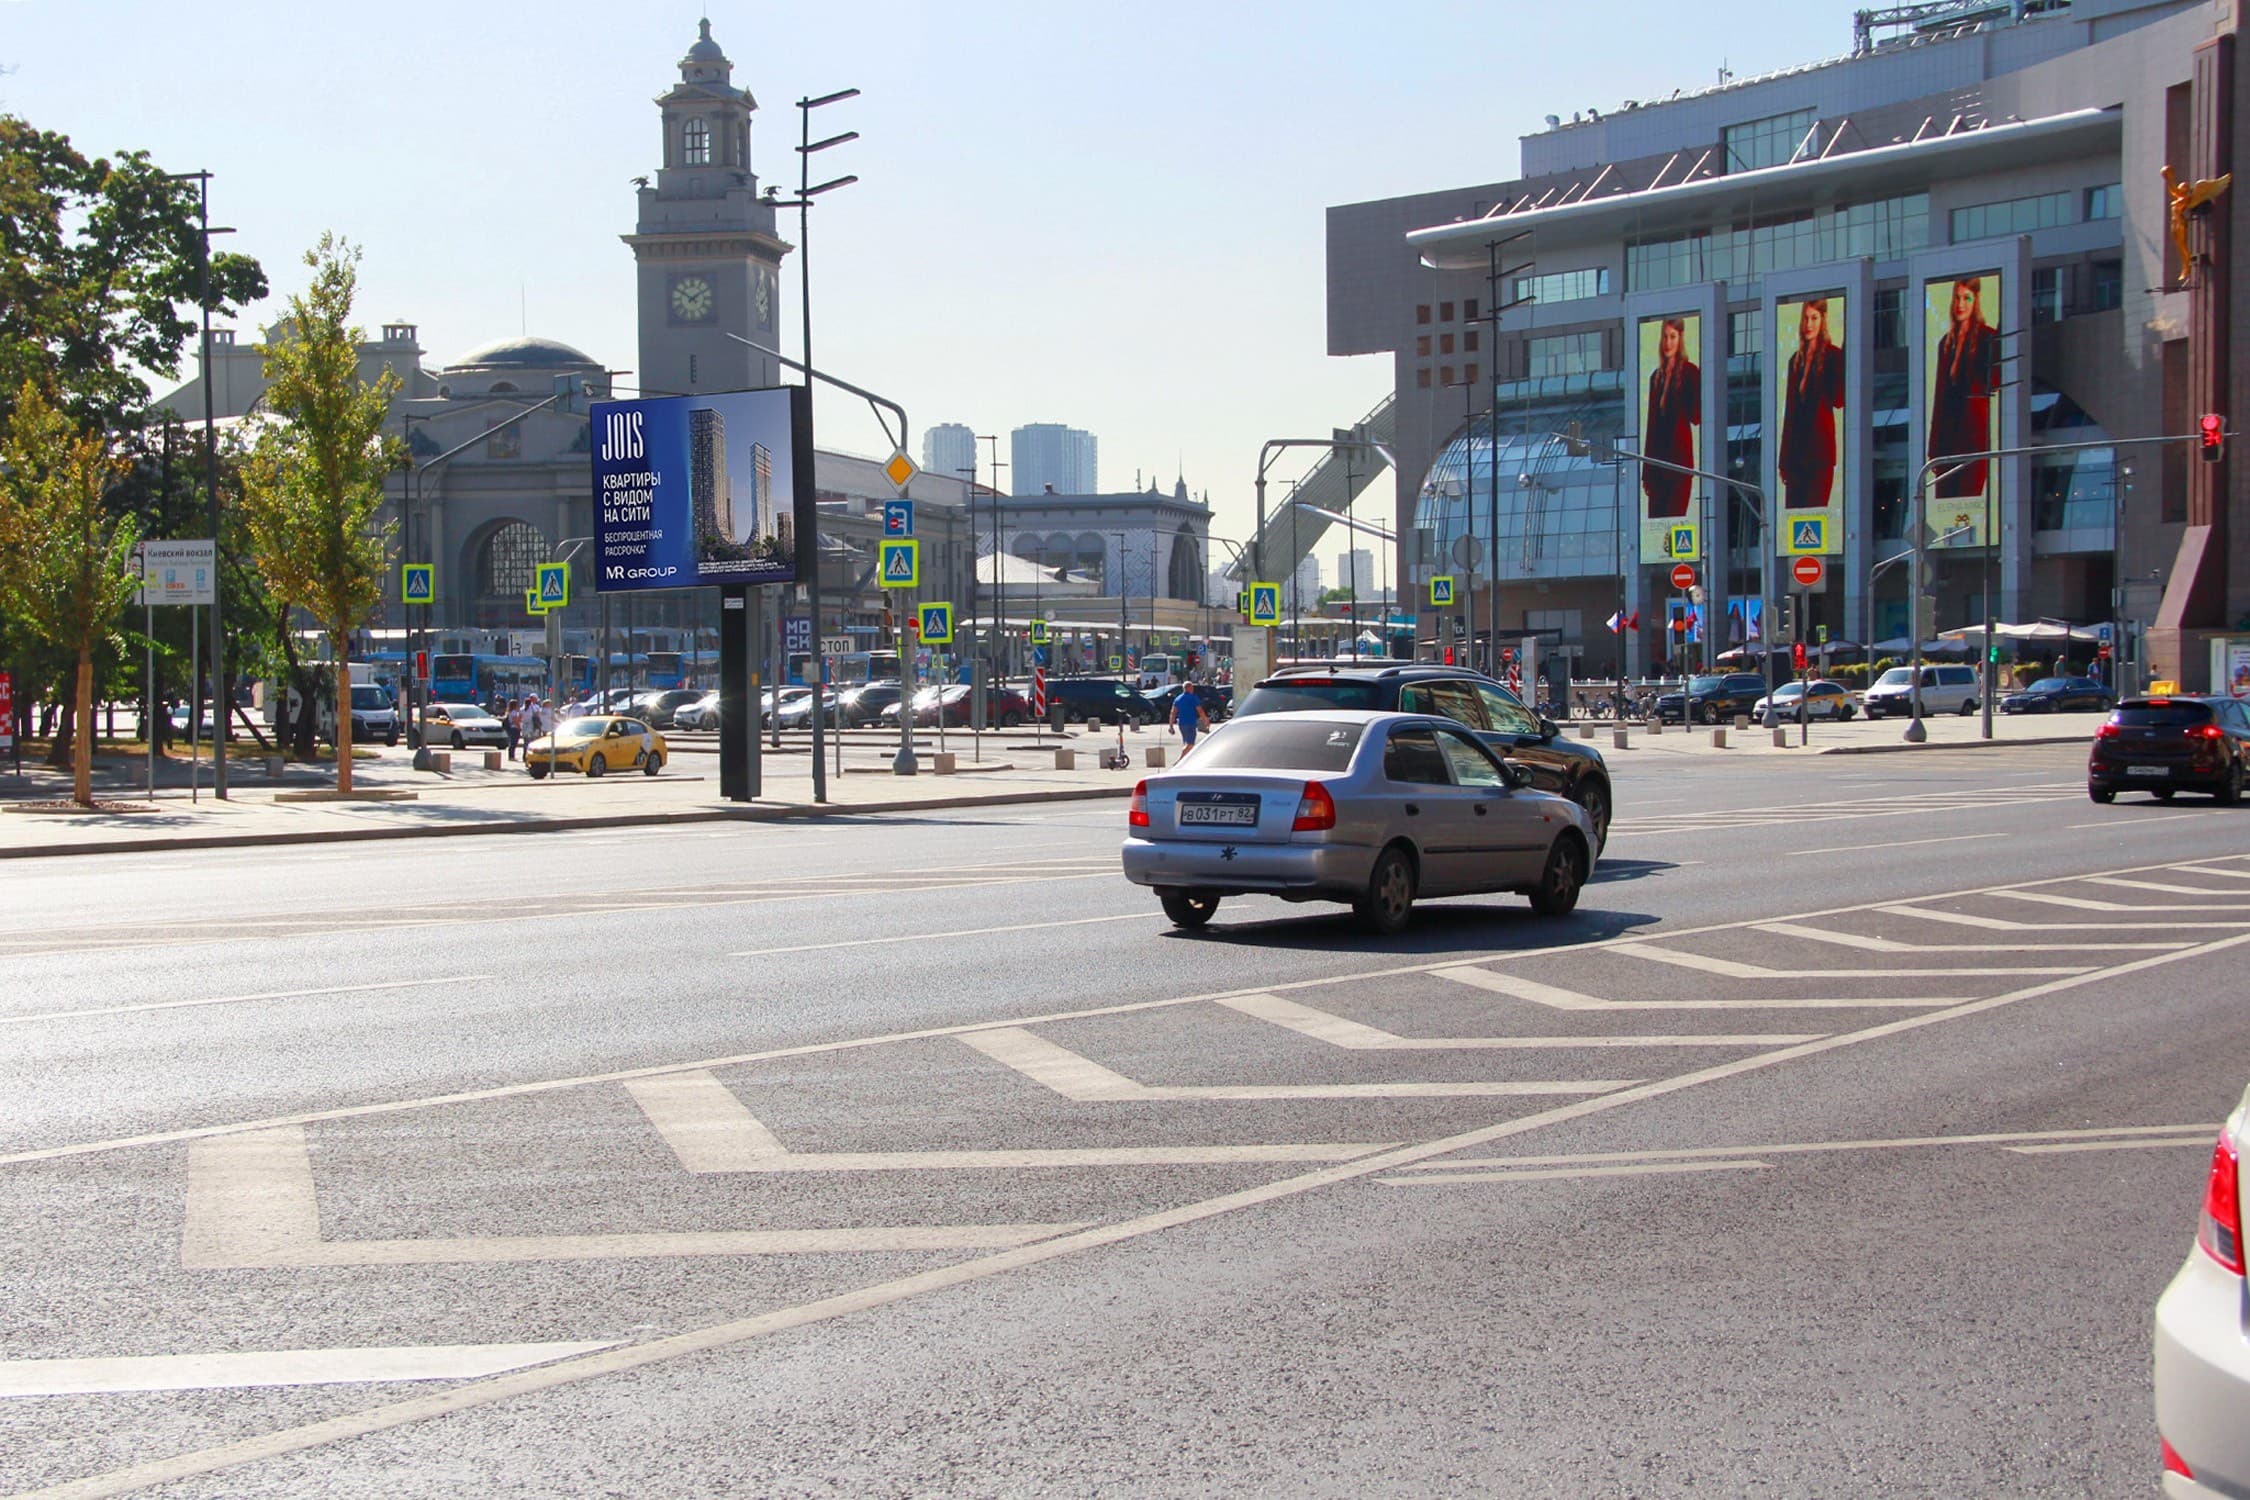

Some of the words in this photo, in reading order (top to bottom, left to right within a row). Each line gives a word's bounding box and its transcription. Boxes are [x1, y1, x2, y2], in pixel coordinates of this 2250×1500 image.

[602, 411, 644, 461] JOIS
[603, 471, 661, 489] КВАРТИРЫ
[603, 491, 611, 506] С
[613, 489, 653, 506] ВИДОМ
[604, 508, 619, 523] НА
[621, 506, 650, 522] СИТИ
[604, 529, 663, 543] БЕСПРОЦЕНТНАЯ
[148, 548, 185, 558] Киевский
[606, 566, 624, 579] MR
[627, 566, 677, 579] GROUP
